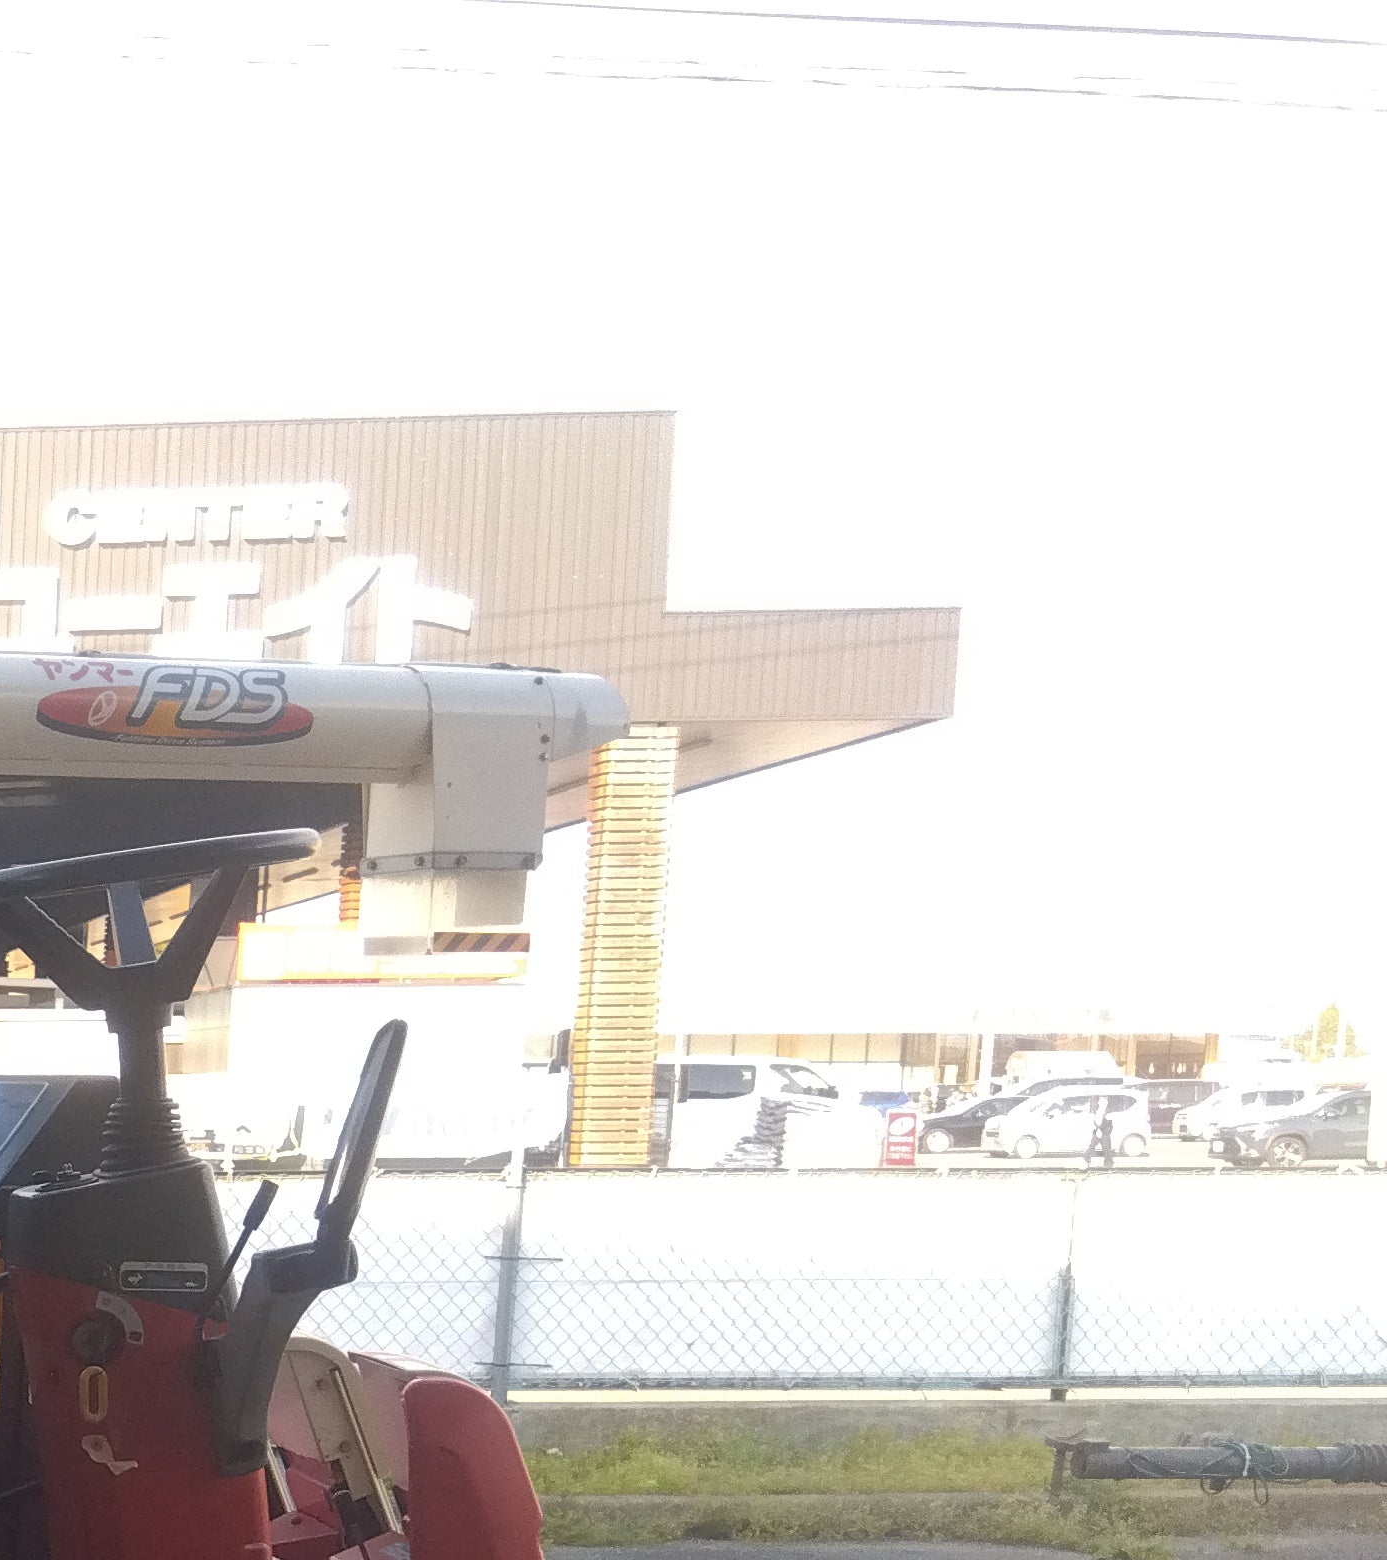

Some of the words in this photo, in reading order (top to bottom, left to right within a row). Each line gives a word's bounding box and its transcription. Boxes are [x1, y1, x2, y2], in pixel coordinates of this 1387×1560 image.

[46, 484, 349, 547] CENTER
[32, 657, 134, 682] ヤンマー
[125, 665, 289, 731] FDS
